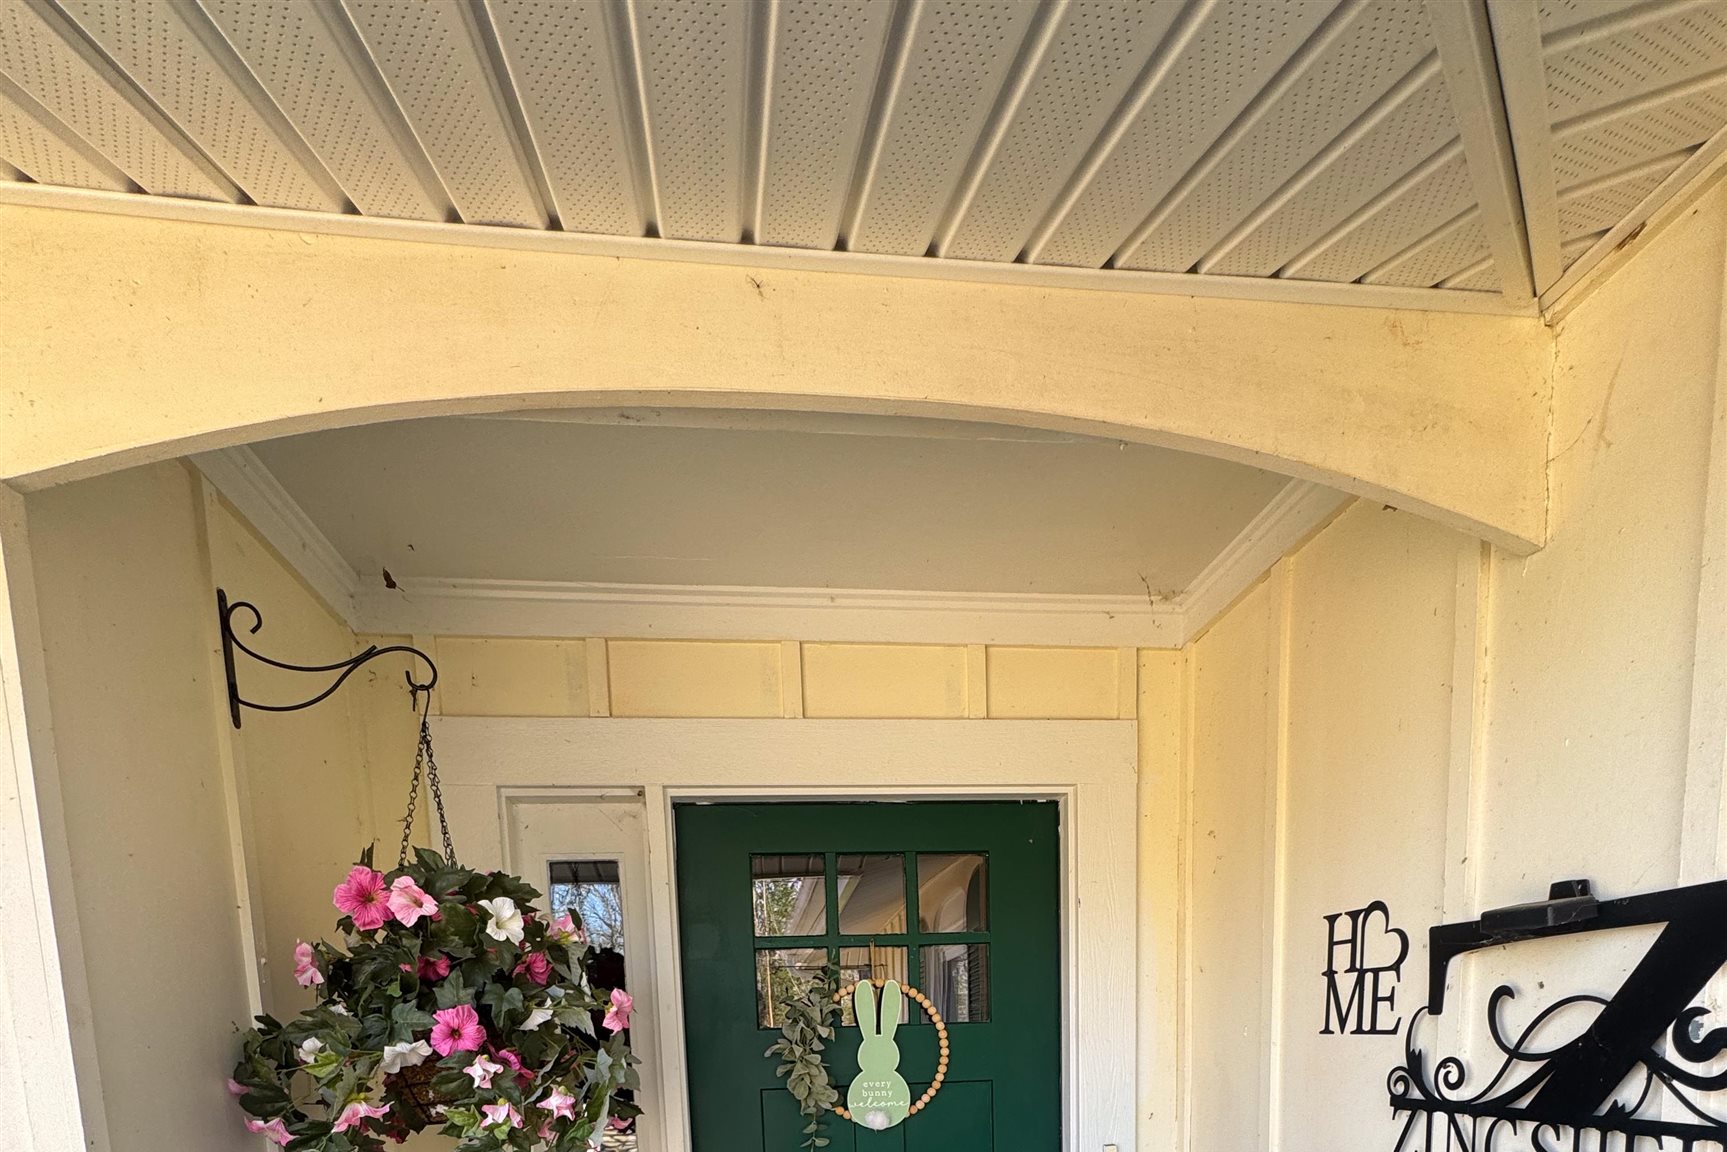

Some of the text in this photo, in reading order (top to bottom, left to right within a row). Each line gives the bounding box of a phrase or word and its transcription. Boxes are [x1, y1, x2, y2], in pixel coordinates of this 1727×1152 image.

[863, 1081, 891, 1090] every
[862, 1089, 893, 1098] bunny
[850, 1097, 908, 1108] welcome
